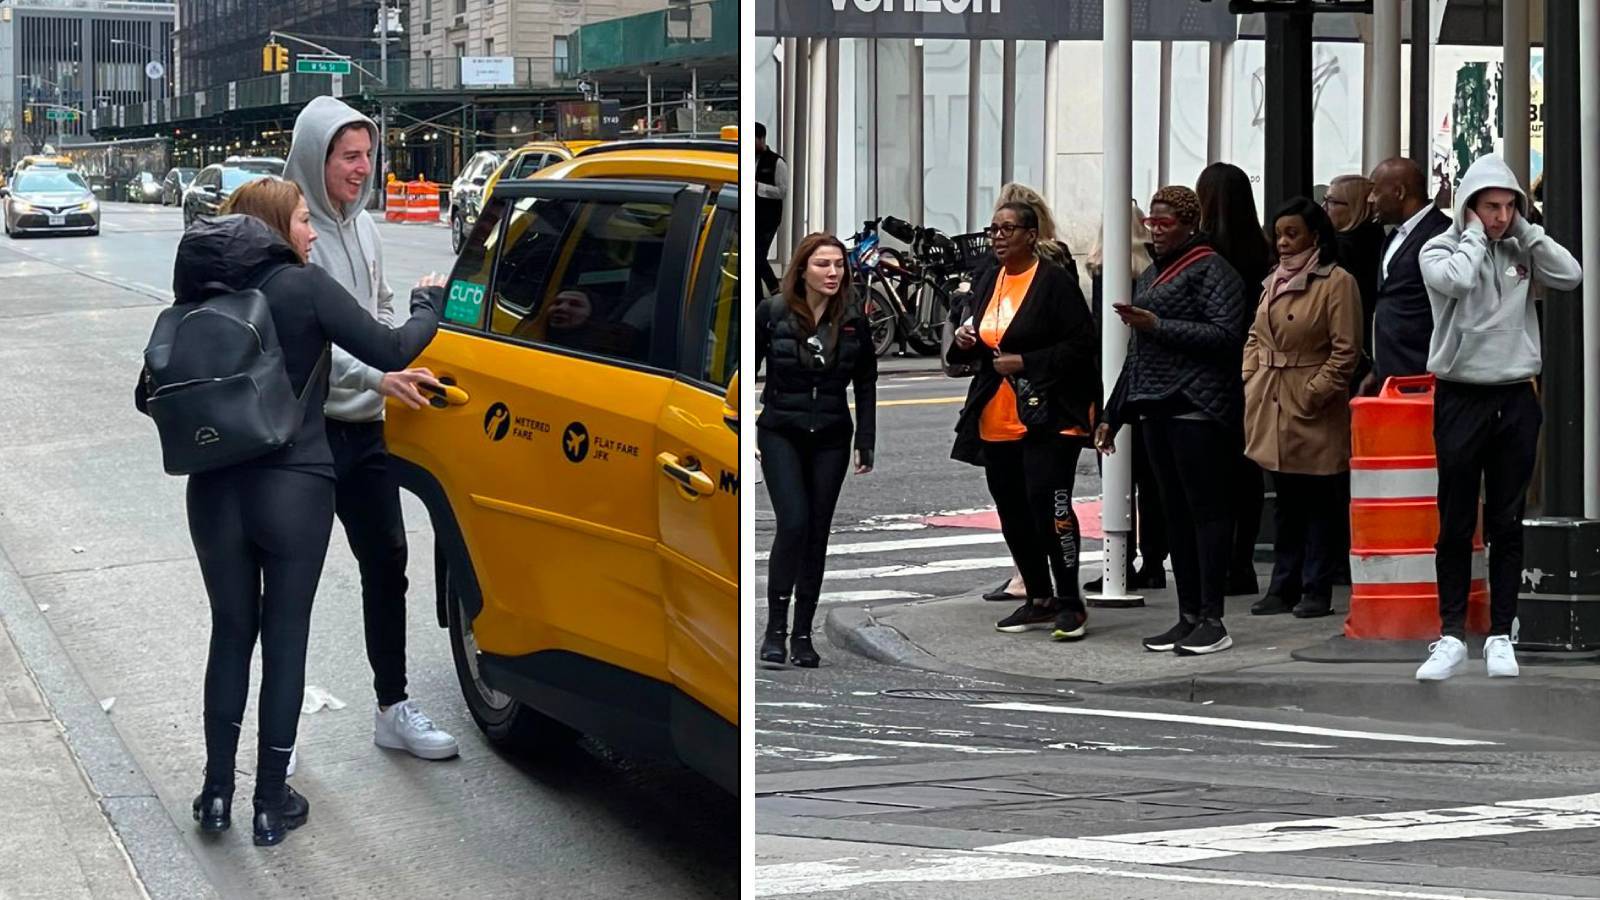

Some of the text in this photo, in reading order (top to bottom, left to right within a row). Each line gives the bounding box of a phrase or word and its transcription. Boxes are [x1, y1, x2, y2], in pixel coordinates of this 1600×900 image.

[450, 284, 484, 305] curb
[514, 416, 551, 433] METERED
[513, 428, 534, 441] FARE
[593, 450, 609, 462] JFK
[594, 436, 639, 457] FLAT FARE
[1054, 489, 1077, 568] LOUIS VUITTON
